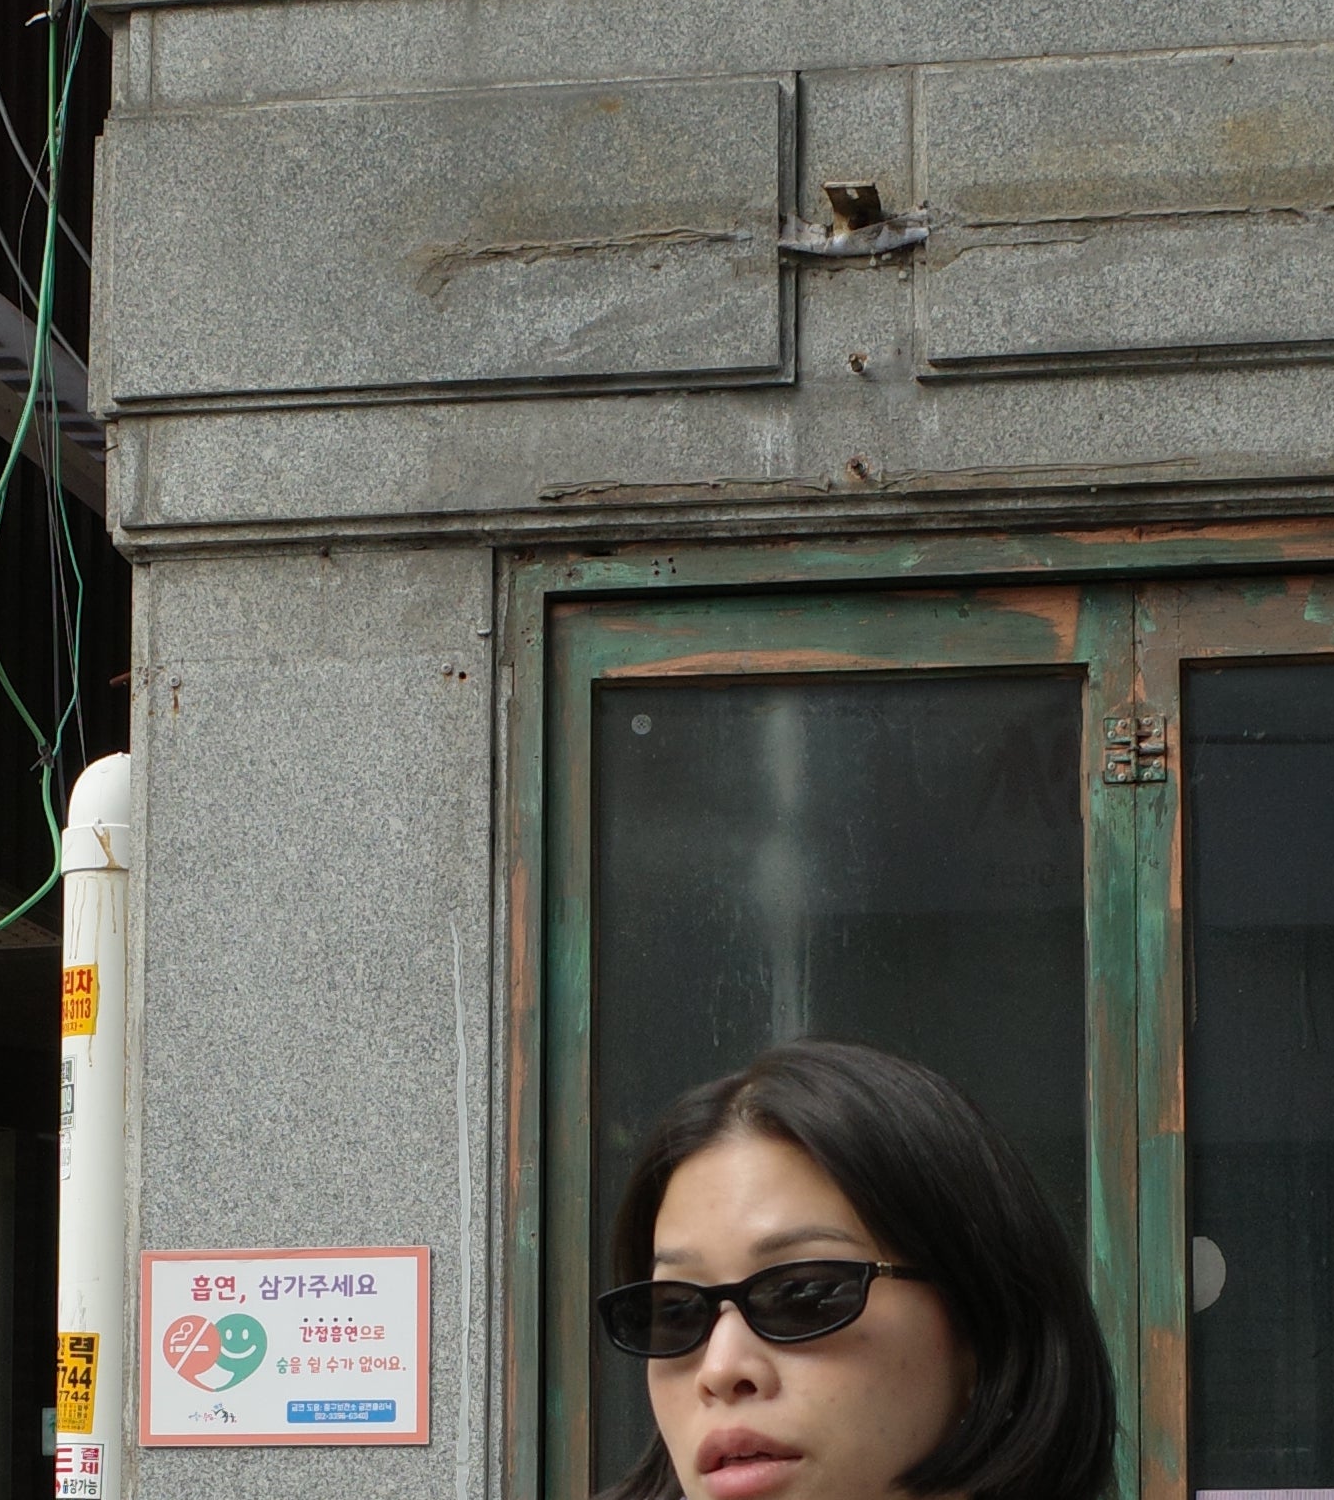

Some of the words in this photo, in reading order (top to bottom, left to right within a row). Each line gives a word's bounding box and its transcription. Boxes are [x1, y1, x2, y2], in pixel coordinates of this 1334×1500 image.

[191, 1275, 246, 1304] 흡연,
[259, 1274, 378, 1300] 삼가주세요
[299, 1325, 385, 1343] 간접흡연으로
[359, 1355, 407, 1374] 없어요.
